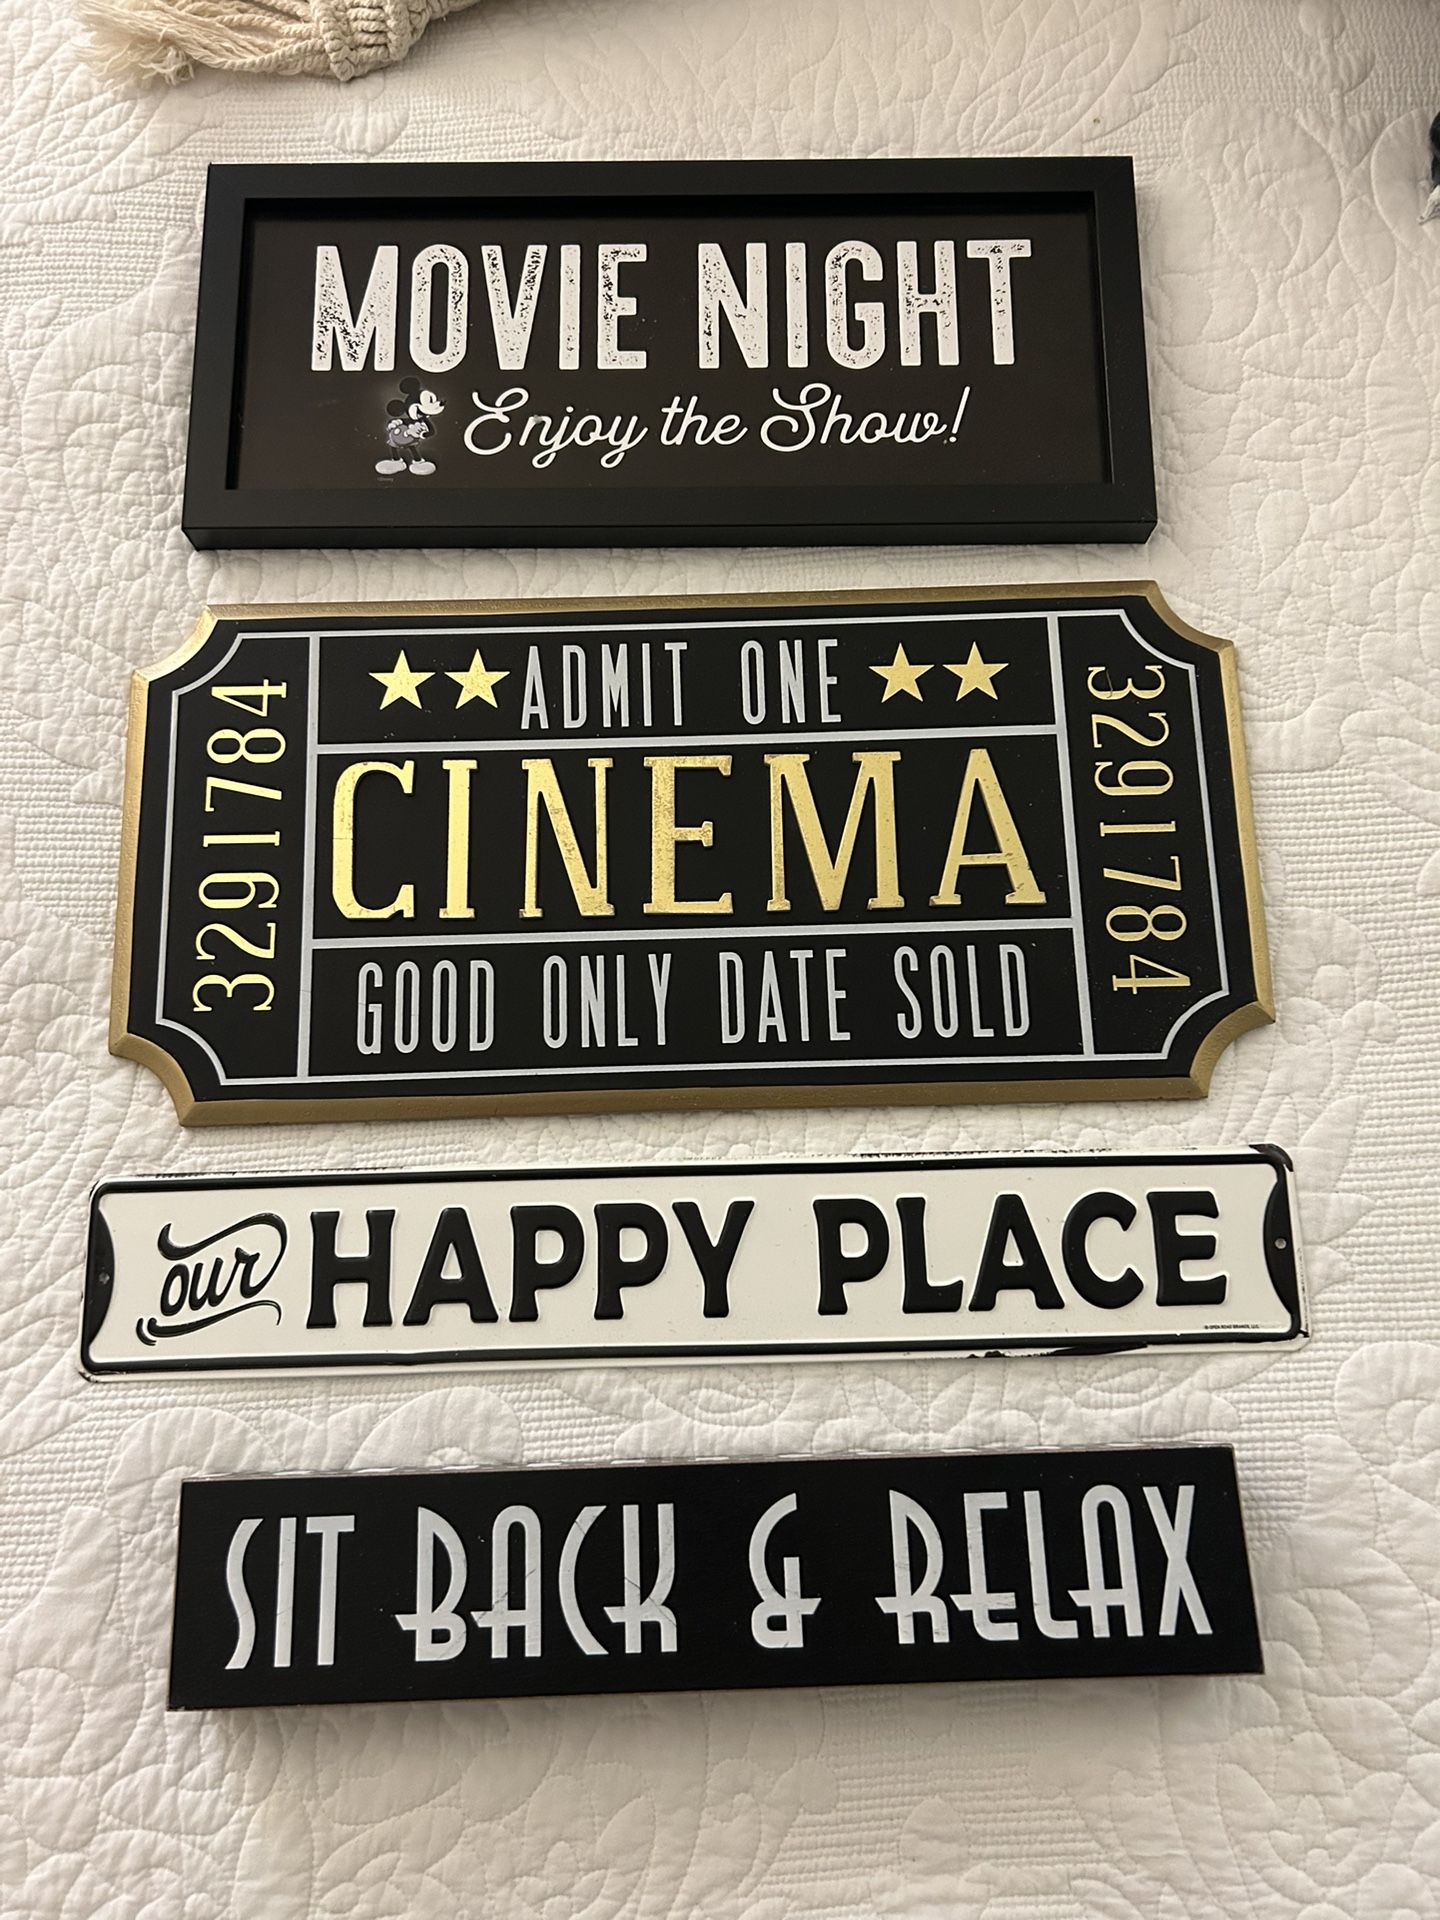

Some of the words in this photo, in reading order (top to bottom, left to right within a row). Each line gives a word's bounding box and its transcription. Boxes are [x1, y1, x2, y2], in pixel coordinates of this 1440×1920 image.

[310, 243, 648, 371] MOVIE
[697, 238, 1032, 370] NIGHT
[463, 387, 649, 469] Enjoy
[660, 395, 747, 446] the
[760, 382, 971, 453] Show!
[520, 641, 688, 730] ADMIT
[740, 638, 842, 725] ONE
[192, 678, 288, 1013] 3291784
[332, 748, 1047, 920] CINEMA
[1086, 664, 1192, 996] 3291784
[356, 959, 495, 1055] GOOD
[543, 953, 672, 1049] ONLY
[718, 948, 851, 1044] DATE
[893, 943, 1030, 1039] SOLD
[157, 1212, 289, 1319] our
[306, 1200, 755, 1330] HAPPY
[812, 1190, 1227, 1316] PLACE
[224, 1514, 355, 1670] SIT
[394, 1503, 678, 1662] BACK
[748, 1492, 822, 1649] &
[874, 1484, 1213, 1645] RELAX
